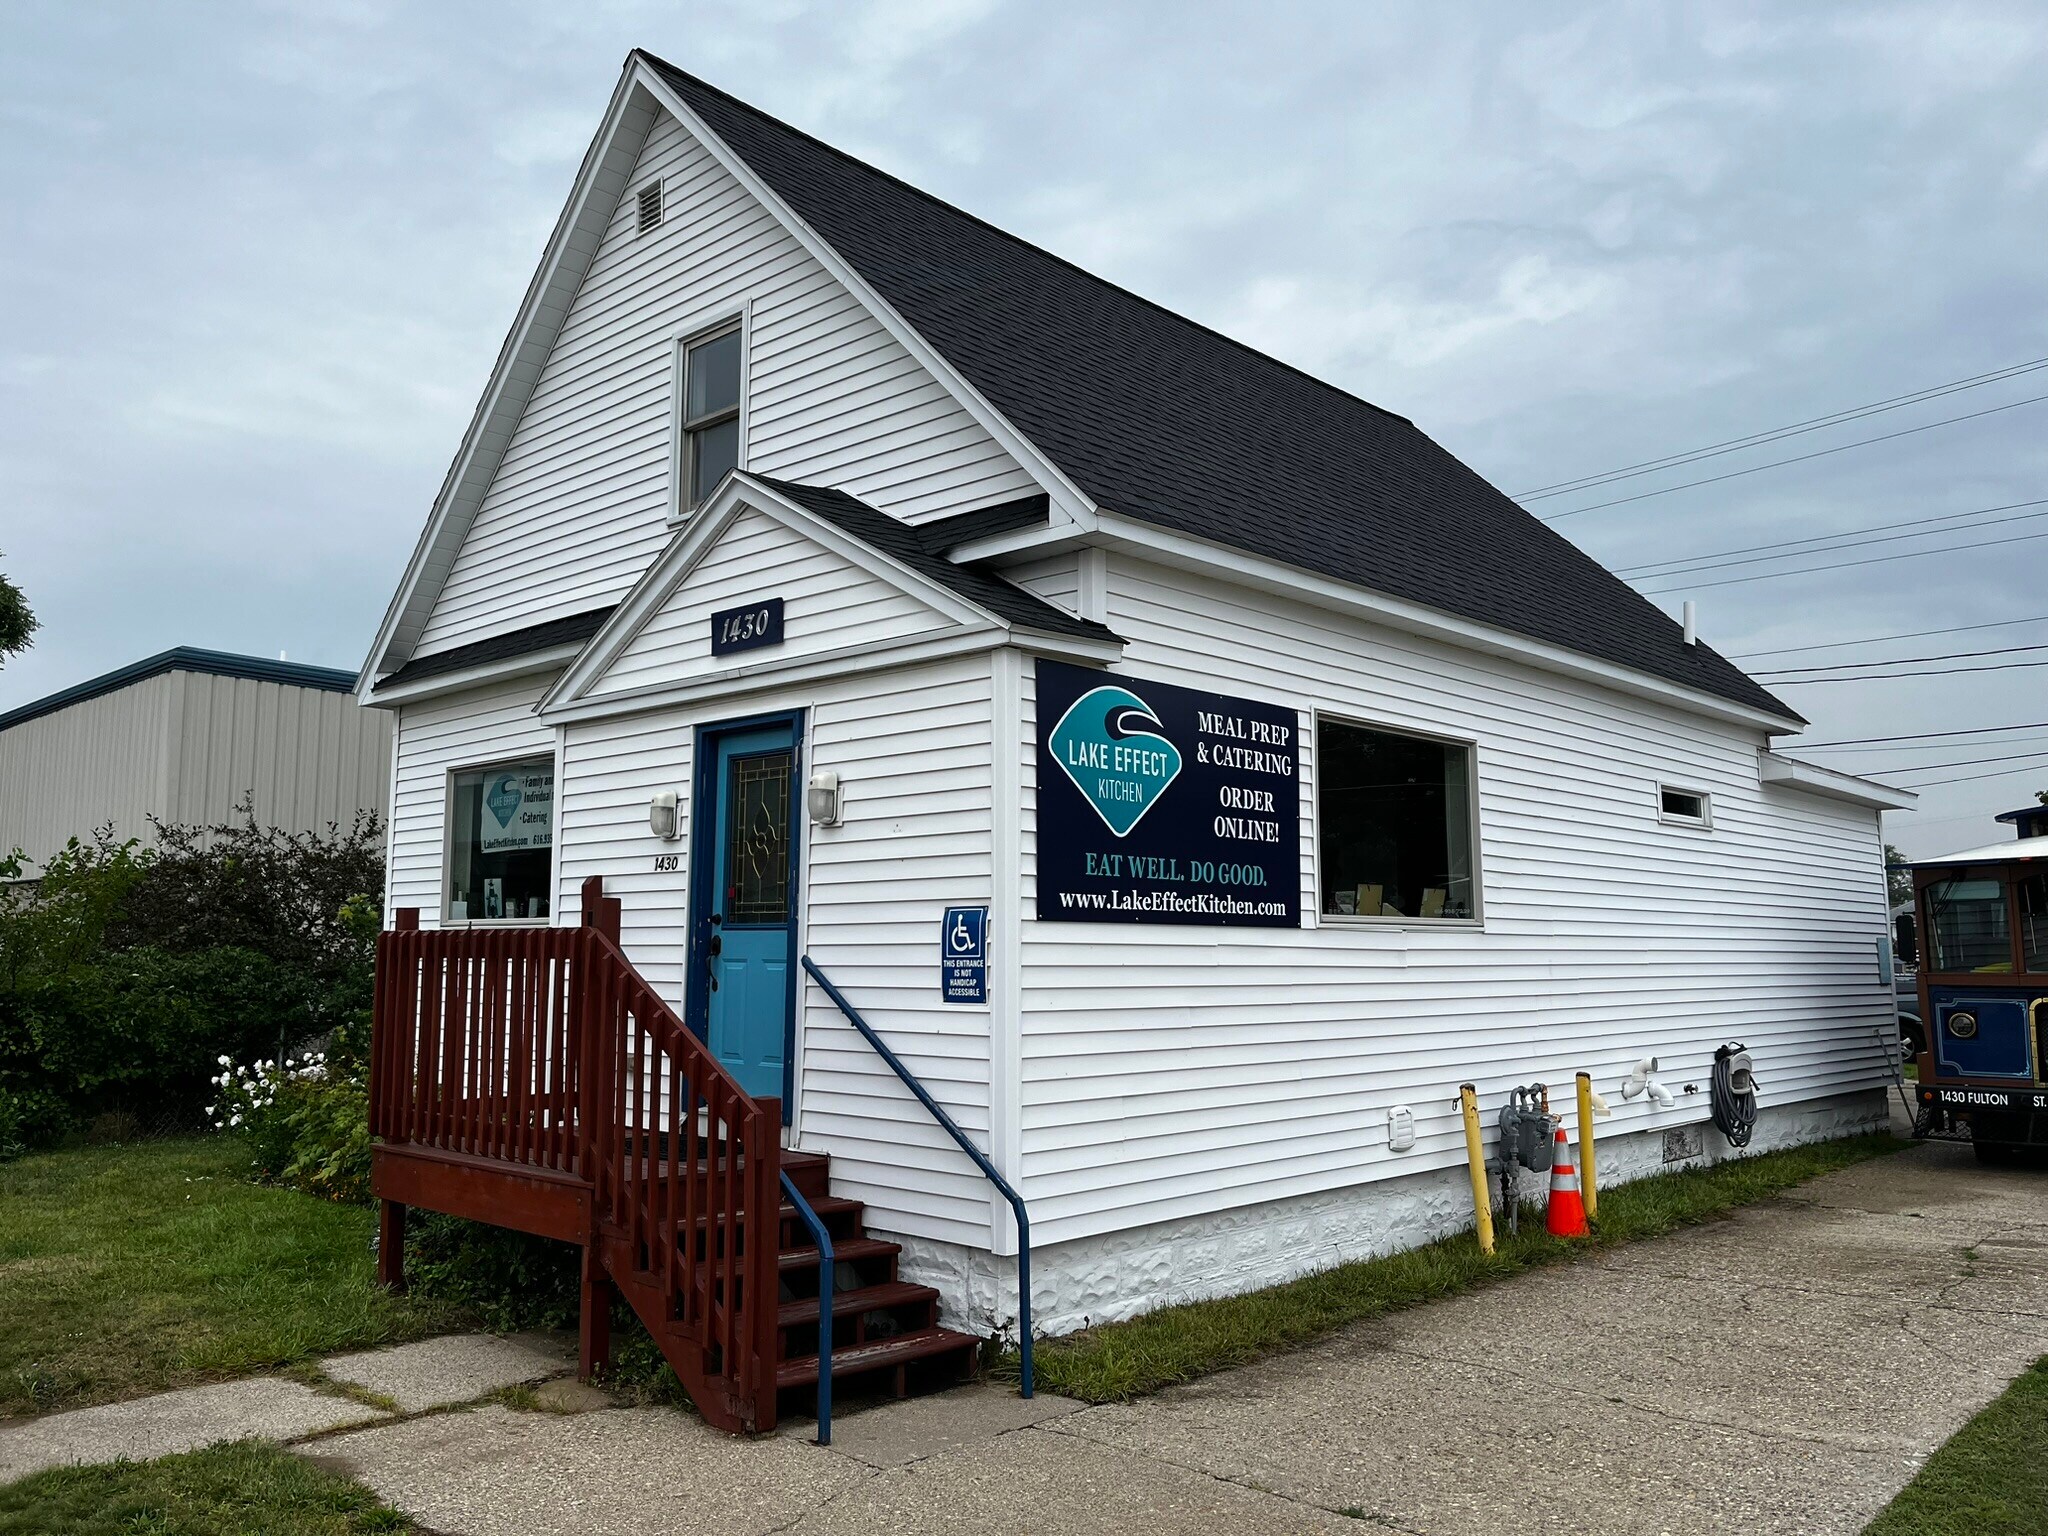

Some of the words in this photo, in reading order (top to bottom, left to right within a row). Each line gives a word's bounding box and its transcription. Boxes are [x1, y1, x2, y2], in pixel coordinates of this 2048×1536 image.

[720, 609, 769, 644] 1430
[1197, 711, 1247, 739] MEAL
[1250, 720, 1290, 747] PREP
[1068, 739, 1109, 770] LAKE
[1115, 746, 1168, 778] EFFECT
[1196, 741, 1209, 764] &
[1212, 744, 1292, 776] CATERING
[1098, 778, 1143, 803] KITCHEN
[1219, 785, 1275, 813] ORDER
[522, 811, 548, 825] Catering
[1214, 815, 1280, 843] ONLINE!
[654, 856, 678, 871] 1430
[1085, 852, 1123, 877] EAT
[1127, 855, 1185, 881] WELL.
[1190, 860, 1215, 884] DO
[1218, 862, 1268, 887] GOOD.
[1059, 889, 1286, 916] www.LakeEffectKitchen.com
[943, 959, 956, 968] THIS
[956, 959, 984, 968] ENTRANCE
[954, 968, 960, 977] IS
[961, 969, 972, 977] NOT
[948, 988, 980, 996] ACCESSIBLE
[949, 978, 977, 987] HANDICAP
[1940, 1090, 1965, 1103] 1430
[1968, 1092, 2009, 1106] FULTON
[2033, 1096, 2047, 1108] ST.
